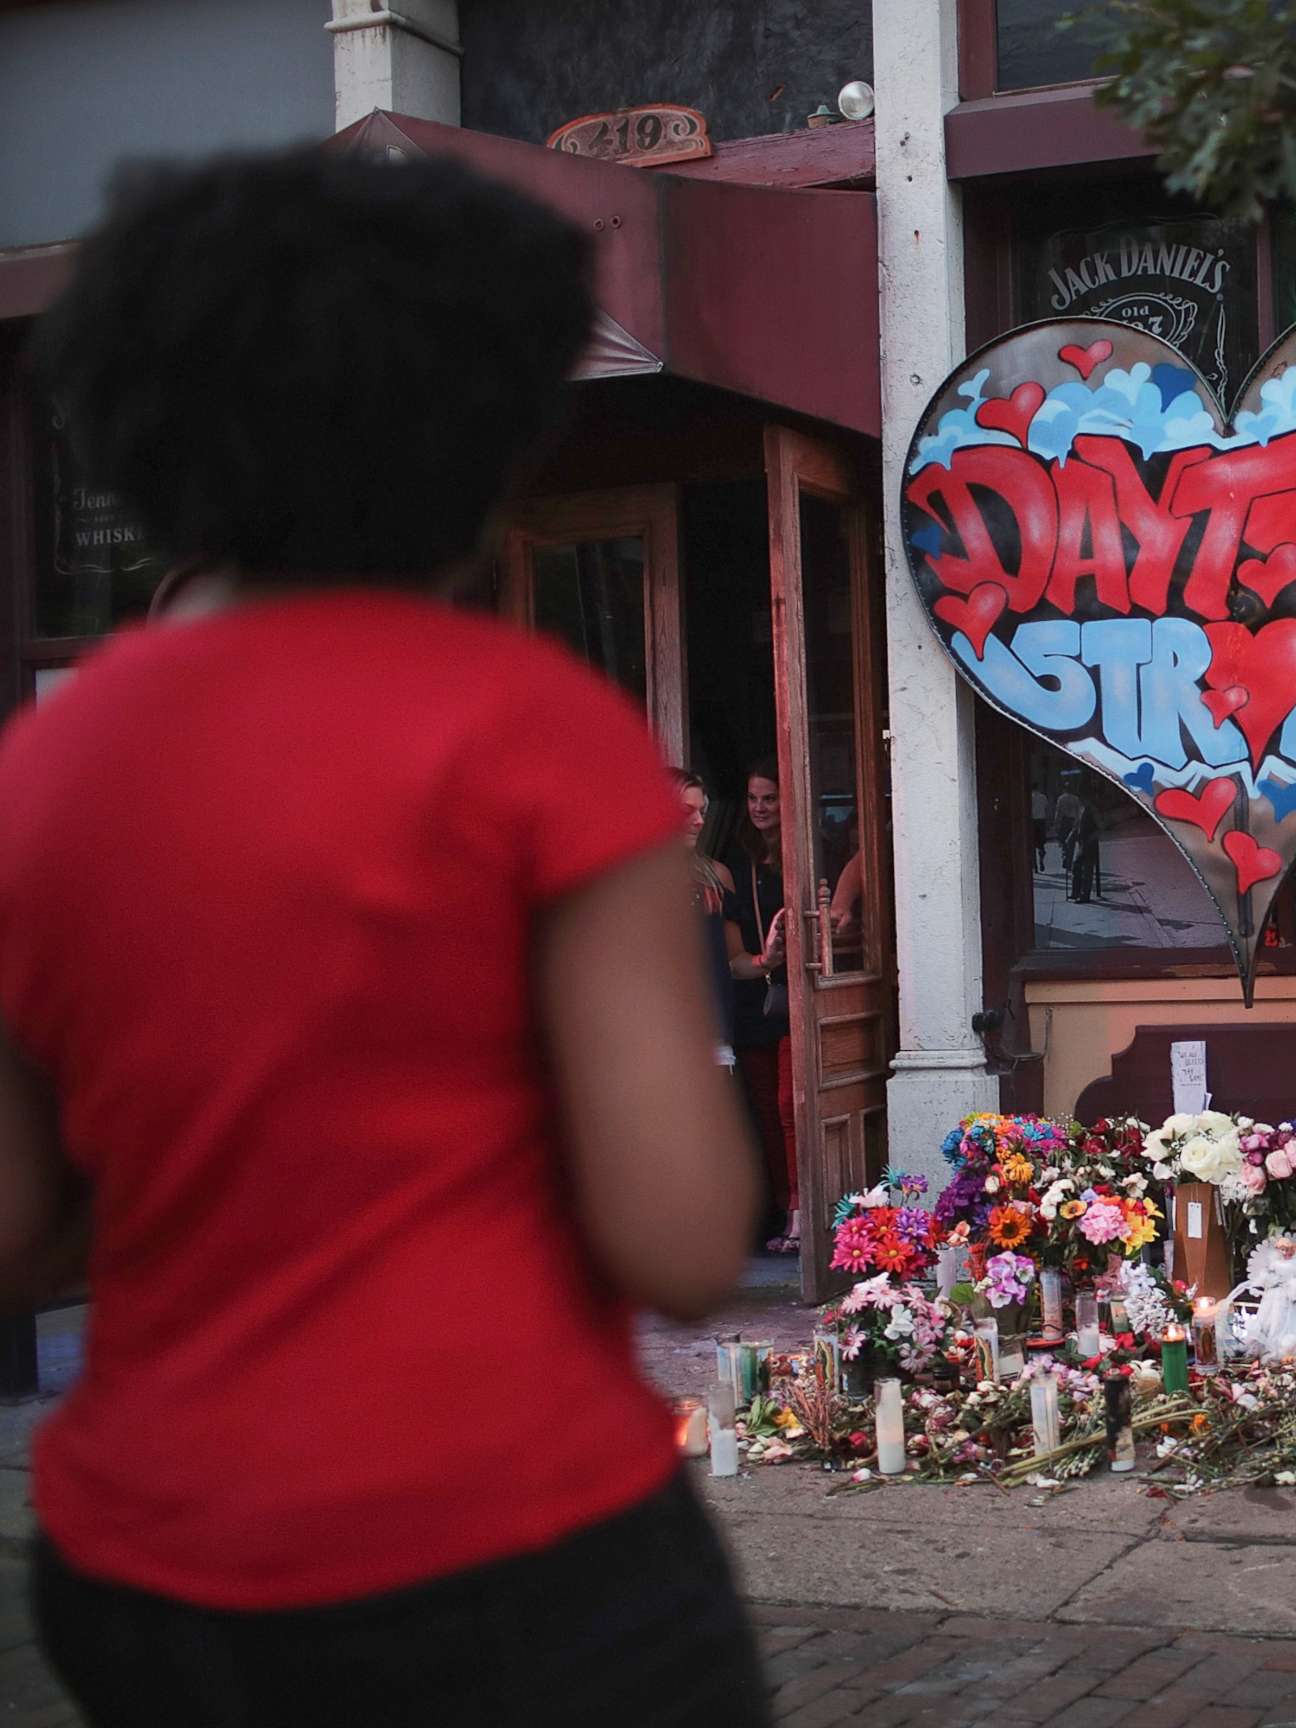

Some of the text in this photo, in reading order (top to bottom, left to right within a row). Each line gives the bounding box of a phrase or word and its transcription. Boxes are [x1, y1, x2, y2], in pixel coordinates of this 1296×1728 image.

[589, 114, 663, 154] 419
[1048, 234, 1231, 310] JACK DANIEL'S
[1122, 304, 1150, 317] Old
